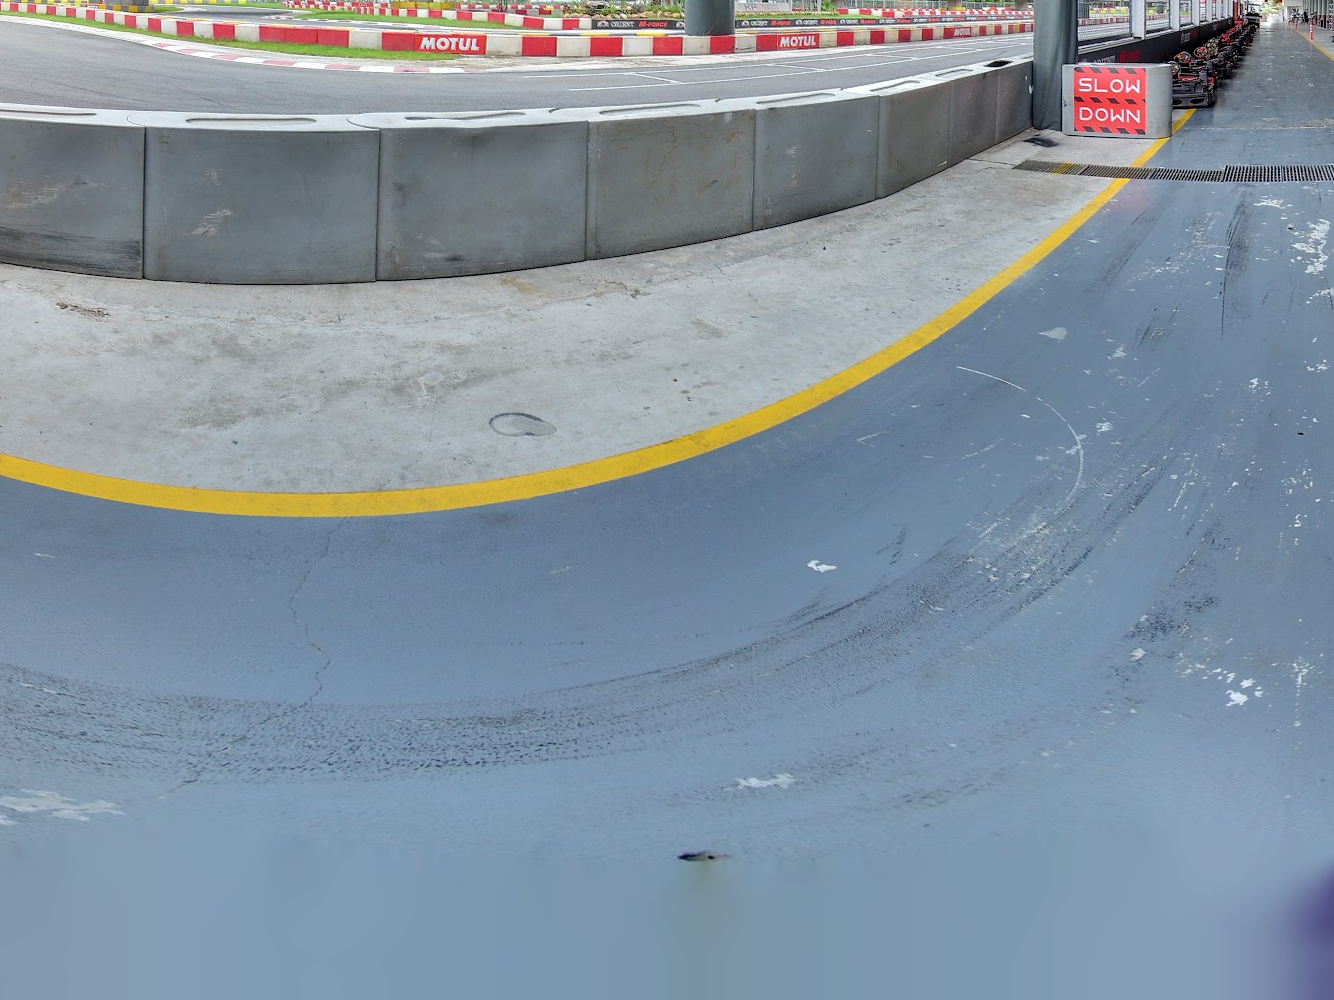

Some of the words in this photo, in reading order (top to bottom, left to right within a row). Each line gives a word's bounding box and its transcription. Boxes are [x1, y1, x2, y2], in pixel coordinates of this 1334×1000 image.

[420, 37, 480, 51] MOTUL
[779, 35, 817, 48] MOTUL
[1078, 77, 1141, 94] SLOW
[1078, 106, 1141, 123] DOWN
